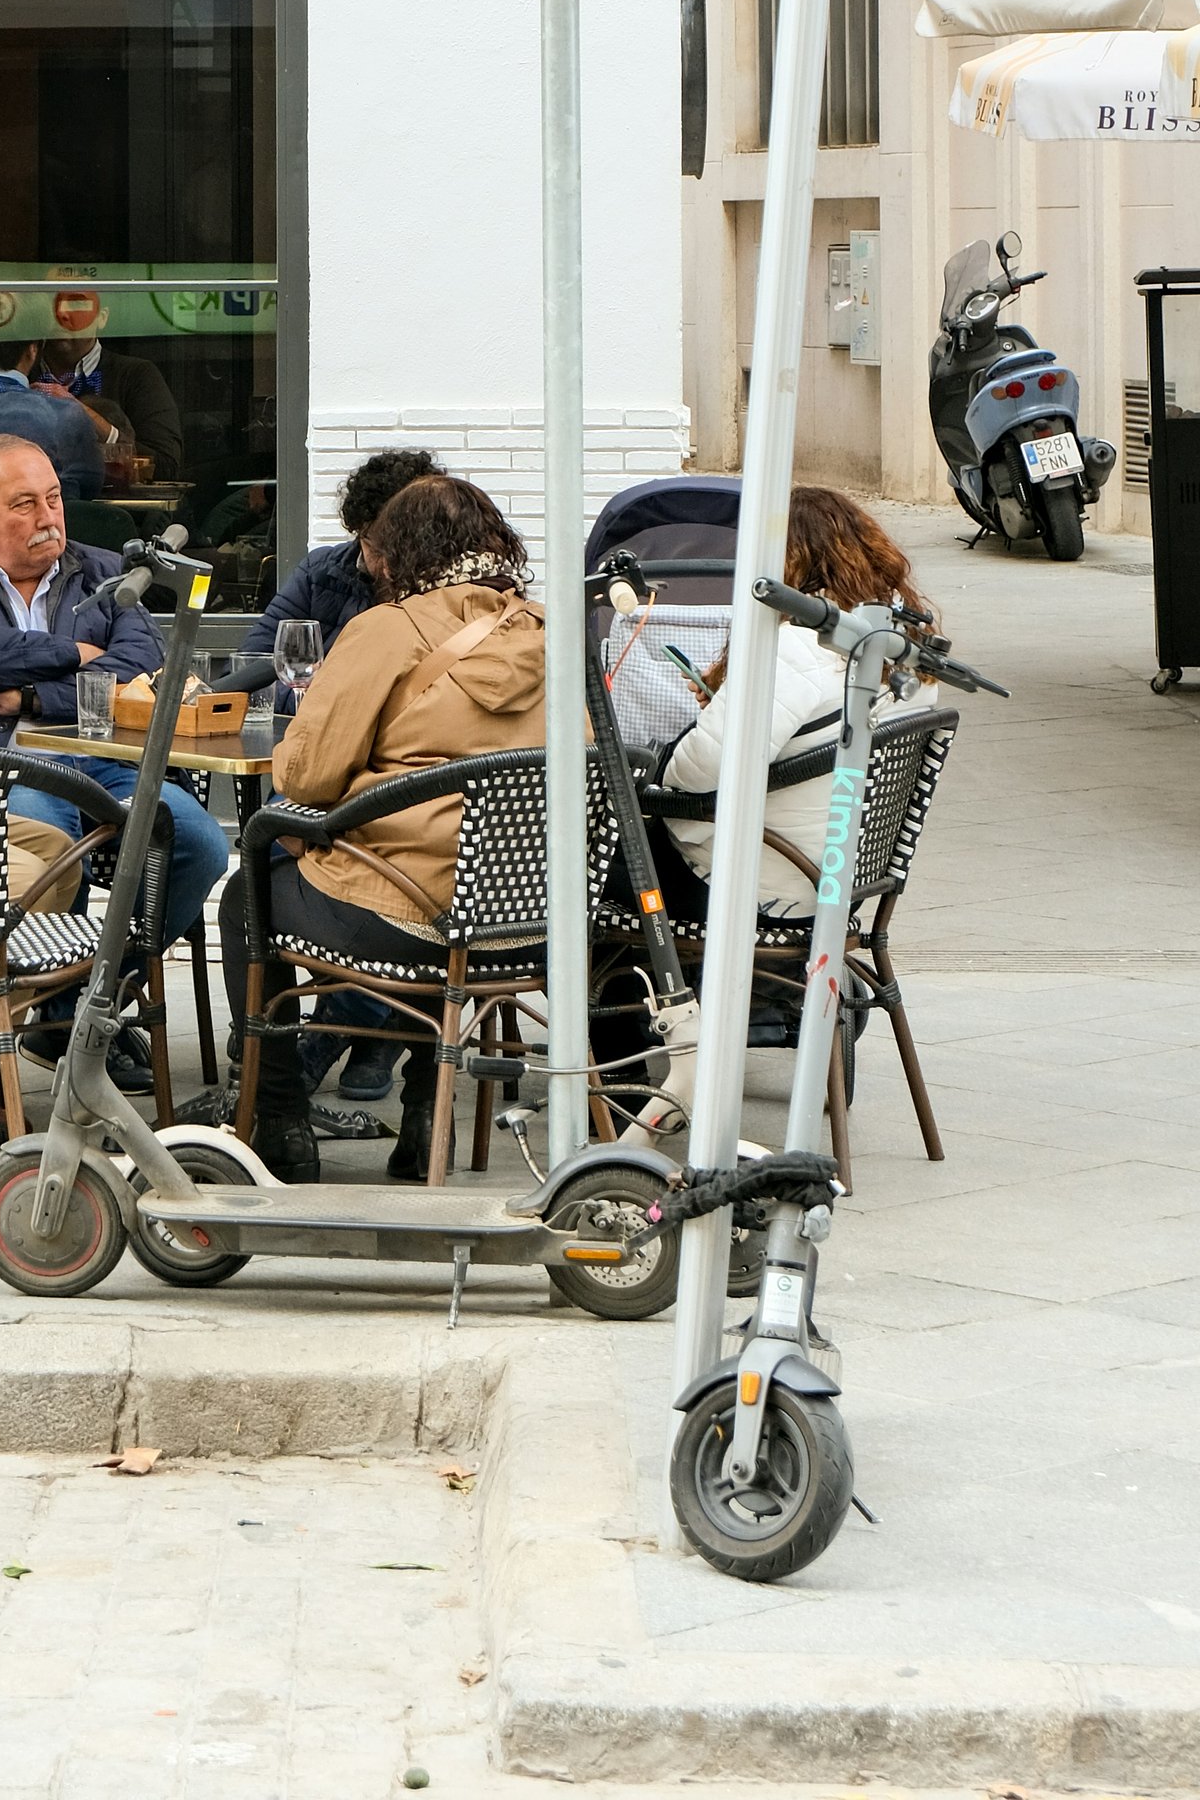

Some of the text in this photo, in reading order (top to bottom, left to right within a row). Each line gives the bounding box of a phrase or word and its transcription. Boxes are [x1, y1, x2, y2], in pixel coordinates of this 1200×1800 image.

[1035, 437, 1071, 455] 5281
[1040, 454, 1069, 472] FNN
[817, 767, 865, 905] kimoa
[651, 913, 665, 946] mi.com
